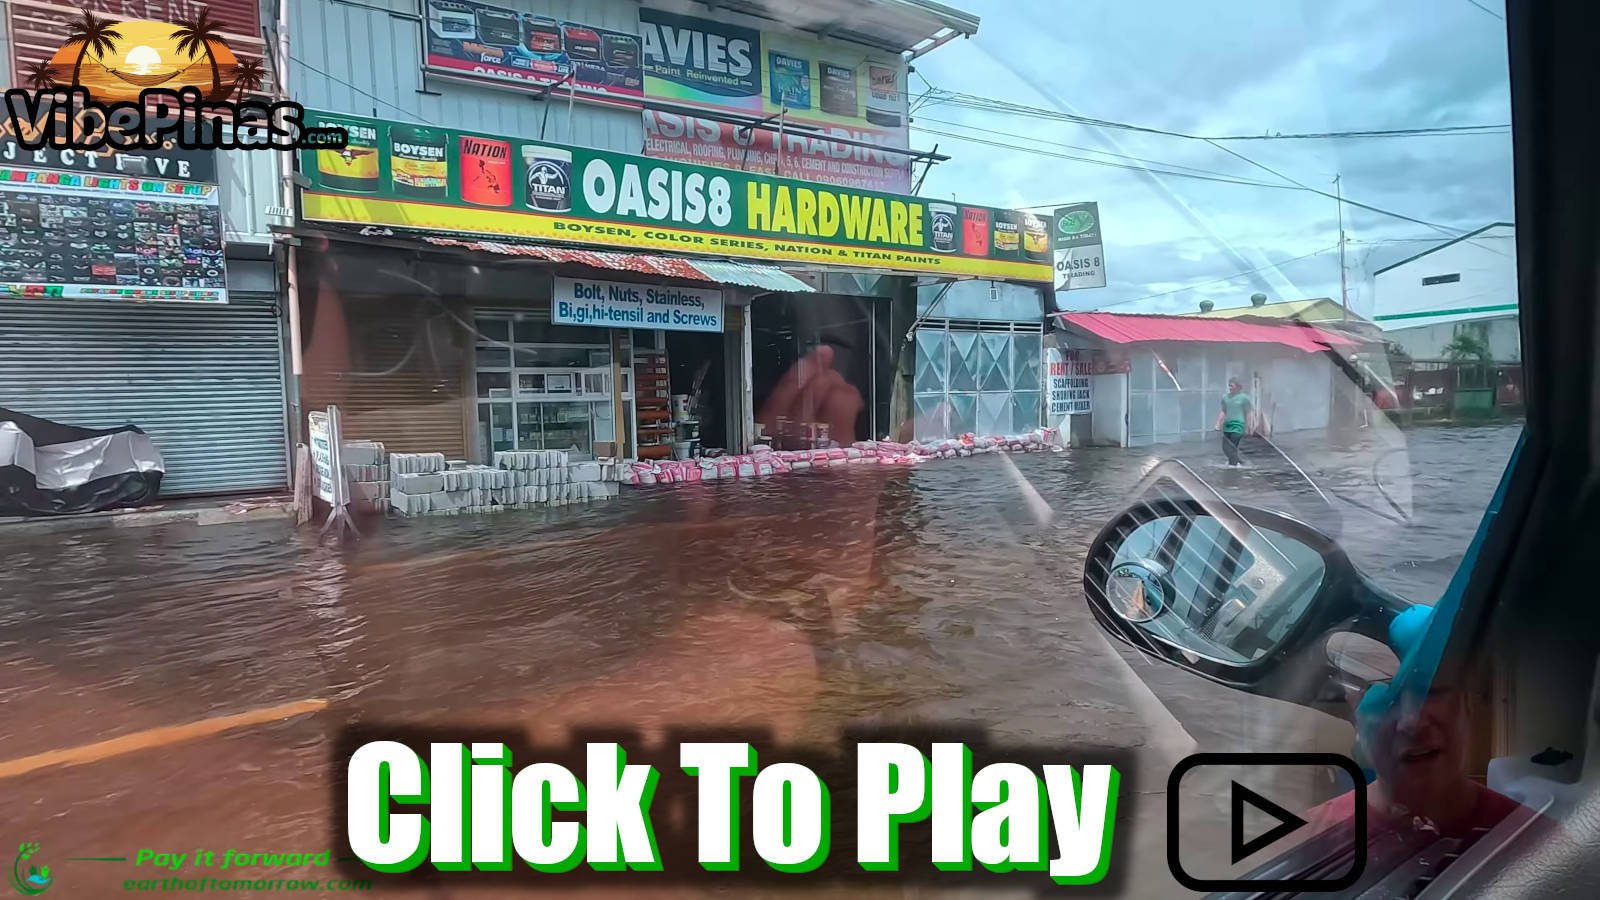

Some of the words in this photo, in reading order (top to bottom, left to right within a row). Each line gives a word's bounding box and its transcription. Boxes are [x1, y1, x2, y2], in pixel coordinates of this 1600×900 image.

[776, 56, 802, 69] DAVIES
[655, 64, 681, 76] Paint
[686, 69, 739, 86] Reinvented
[394, 142, 443, 158] BOYSEN
[463, 138, 507, 159] NATION
[532, 183, 565, 194] TITAN
[582, 158, 732, 227] OASIS8
[747, 181, 924, 248] HARDWARE
[553, 221, 637, 239] BOYSEN,
[643, 231, 705, 244] COLOR
[710, 238, 769, 251] SERIES,
[774, 244, 833, 256] NATION
[838, 249, 848, 257] &
[853, 250, 892, 261] TITAN
[896, 254, 941, 265] PAINTS
[1056, 257, 1091, 272] OASIS
[1094, 256, 1101, 267] 8
[574, 283, 605, 303] Bolt,
[609, 286, 643, 306] Nuts,
[646, 289, 705, 310] Stainless,
[647, 309, 669, 323] and
[673, 310, 717, 326] Screws
[1050, 362, 1069, 375] RENT
[1076, 362, 1092, 375] SALE
[1051, 401, 1073, 412] CEMENT
